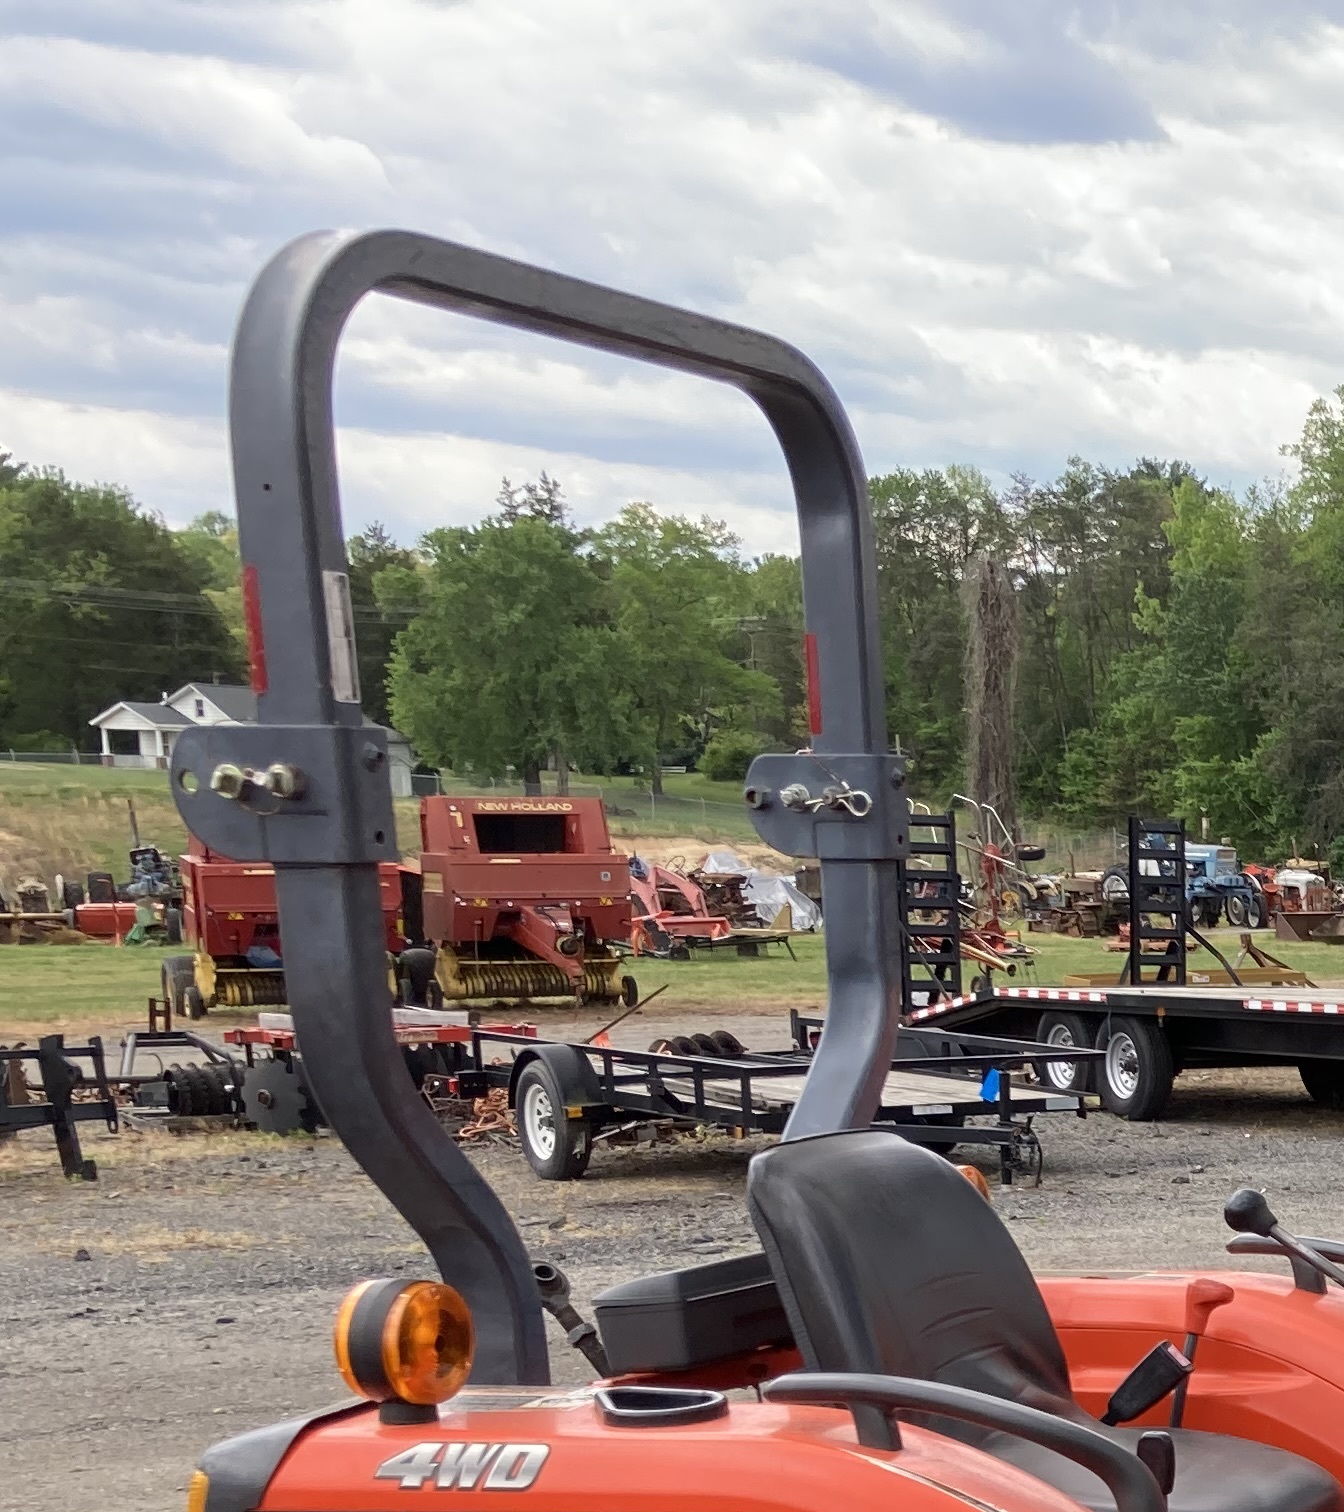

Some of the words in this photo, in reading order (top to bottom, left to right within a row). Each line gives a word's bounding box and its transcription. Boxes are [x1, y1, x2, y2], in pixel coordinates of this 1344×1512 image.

[477, 802, 508, 812] NEW
[509, 802, 573, 812] HOLLAND
[373, 1441, 552, 1491] 4WD
